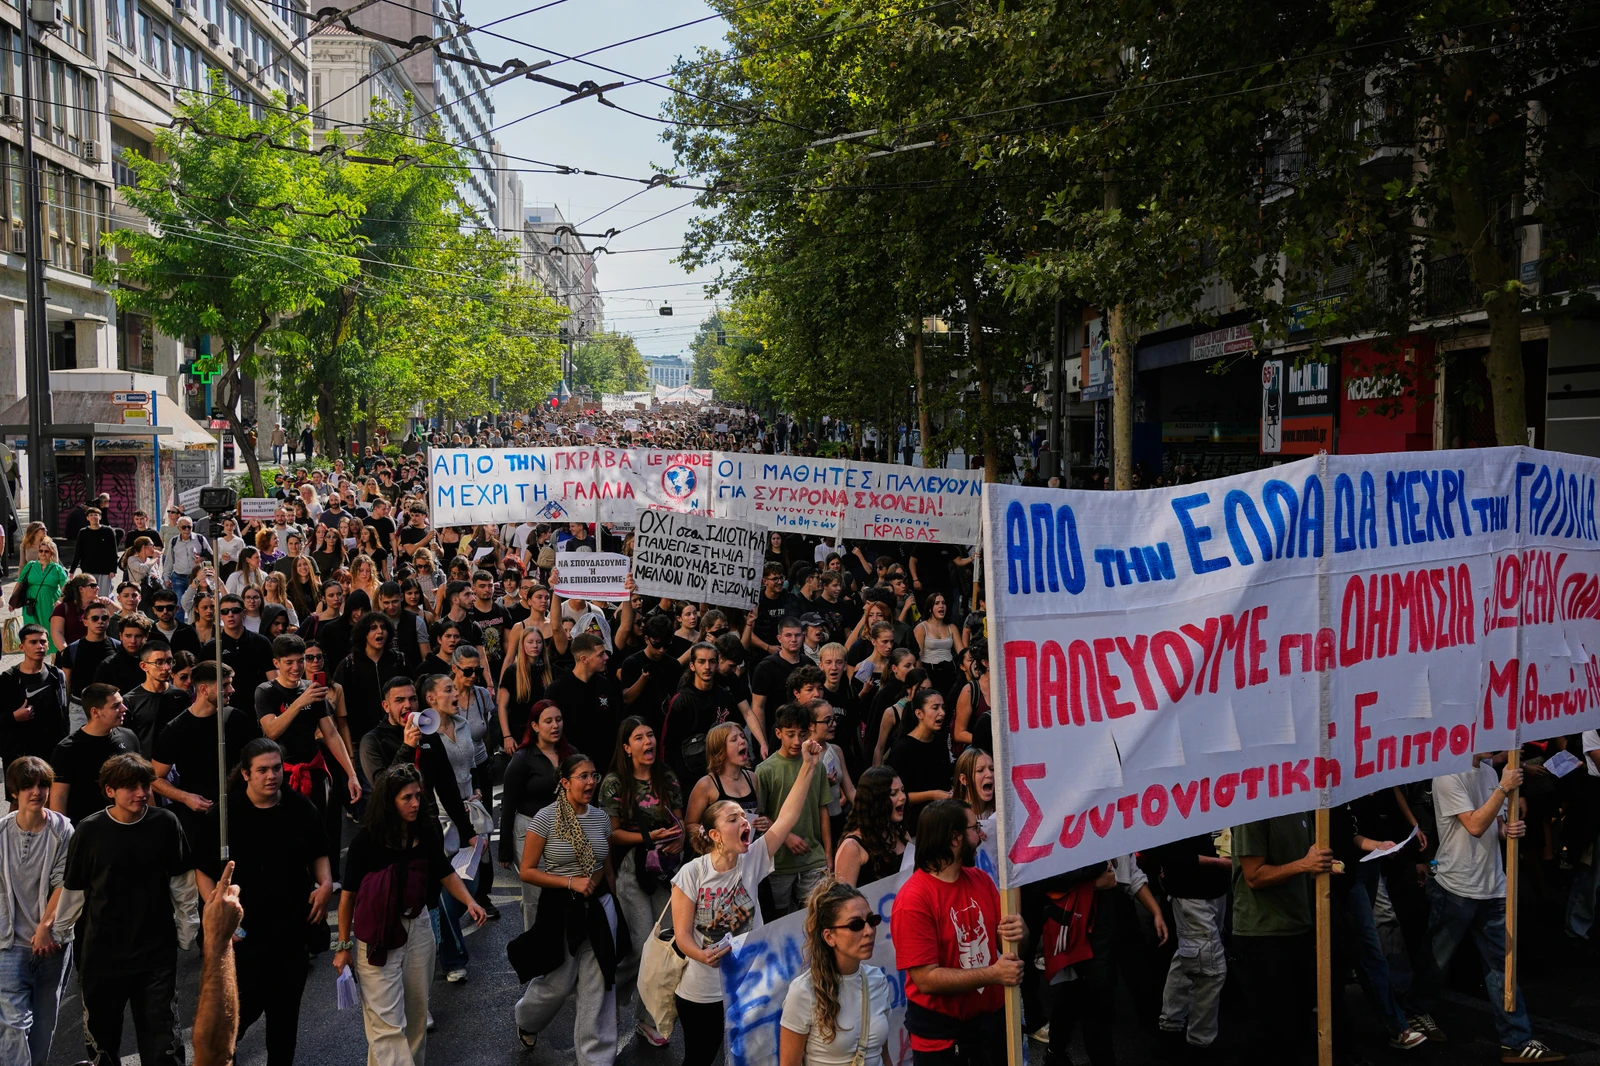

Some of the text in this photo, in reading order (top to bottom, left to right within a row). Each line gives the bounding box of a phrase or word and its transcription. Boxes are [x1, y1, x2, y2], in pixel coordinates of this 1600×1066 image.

[434, 450, 632, 475] ΑΠΟ ΤΗΝ ΓΚΡΑΒΑ
[648, 453, 712, 467] LE MONDE
[718, 460, 982, 497] ΟΙ ΜΑΘΗΤΕΣ ΠΑΛΕΥΟΥΝ
[438, 481, 635, 507] ΜΕΧΡΙ ΤΗ ΓΑΛΛΙΑ
[719, 485, 944, 517] ΓΙΑ ΣΥΓΧΡΟΝΑ ΣΧΟΛΕΙΑ!
[640, 510, 674, 534] ΟΧΙ
[706, 524, 766, 554] ΙΔΙΩΤΙΚΑ
[863, 524, 941, 543] ΓΚΡΑΒΑΣ
[1007, 499, 1086, 595] ΑΠΟ
[1094, 541, 1176, 588] ΤΗΝ
[1386, 469, 1473, 547] ΜΕΧΡΙ
[1471, 495, 1509, 533] ΤΗΝ
[1515, 462, 1599, 541] ΓΑΛΛΙΑ
[558, 558, 627, 568] ΝΑ ΣΠΟΥΔΑΣΟΥΜΕ
[637, 535, 744, 563] ΠΑΝΕΠΙΣΤΗΜΙΑ
[558, 576, 569, 585] ΝΑ
[637, 551, 756, 581] ΔΙΚΑΙΟΥΜΑΣΤΕ ΤΟ
[634, 565, 759, 605] ΜΕΛΛΟΝ ΠΟΥ ΑΞΙΖΟΥΜΕ
[1004, 605, 1269, 732] ΠΑΛΕΥΟΥΜΕ
[1279, 627, 1337, 676] ΓΙΑ
[1340, 562, 1475, 667] ΔΗΜΟΣΙΑ
[1354, 691, 1477, 779] Επιτρο
[1483, 658, 1588, 731] Μθητών
